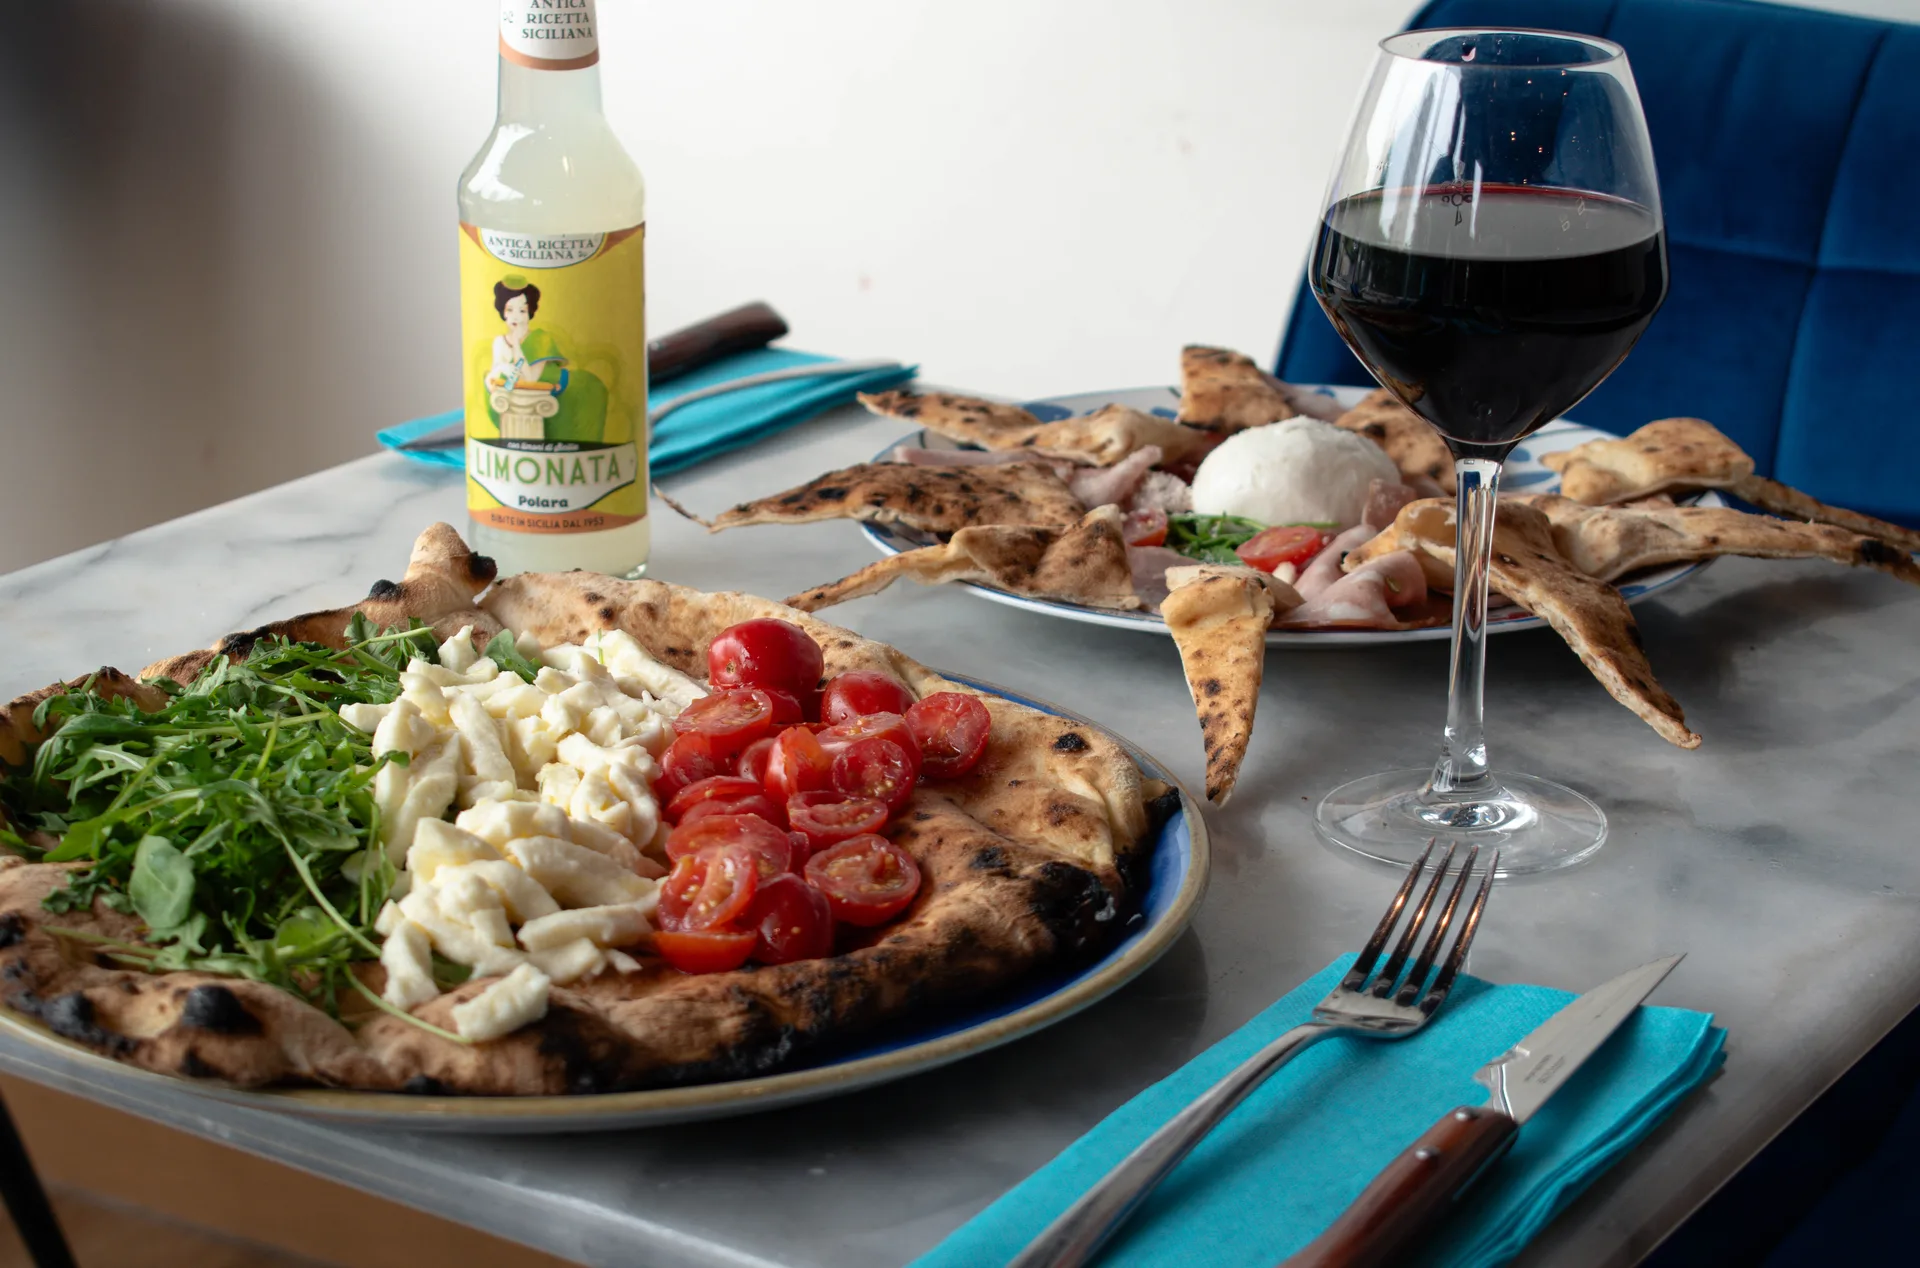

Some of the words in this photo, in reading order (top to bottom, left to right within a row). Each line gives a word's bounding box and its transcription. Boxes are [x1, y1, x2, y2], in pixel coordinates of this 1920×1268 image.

[530, 0, 586, 8] ANTICA
[526, 12, 590, 24] RICETTA
[521, 27, 593, 39] SICILIANA
[488, 236, 531, 248] ANTICA
[537, 239, 595, 250] RICETTA
[509, 249, 574, 260] SICILIANA
[475, 448, 620, 485] LIMONATA
[518, 495, 569, 508] Polara
[527, 519, 560, 529] SICILIA
[563, 518, 581, 528] DAL
